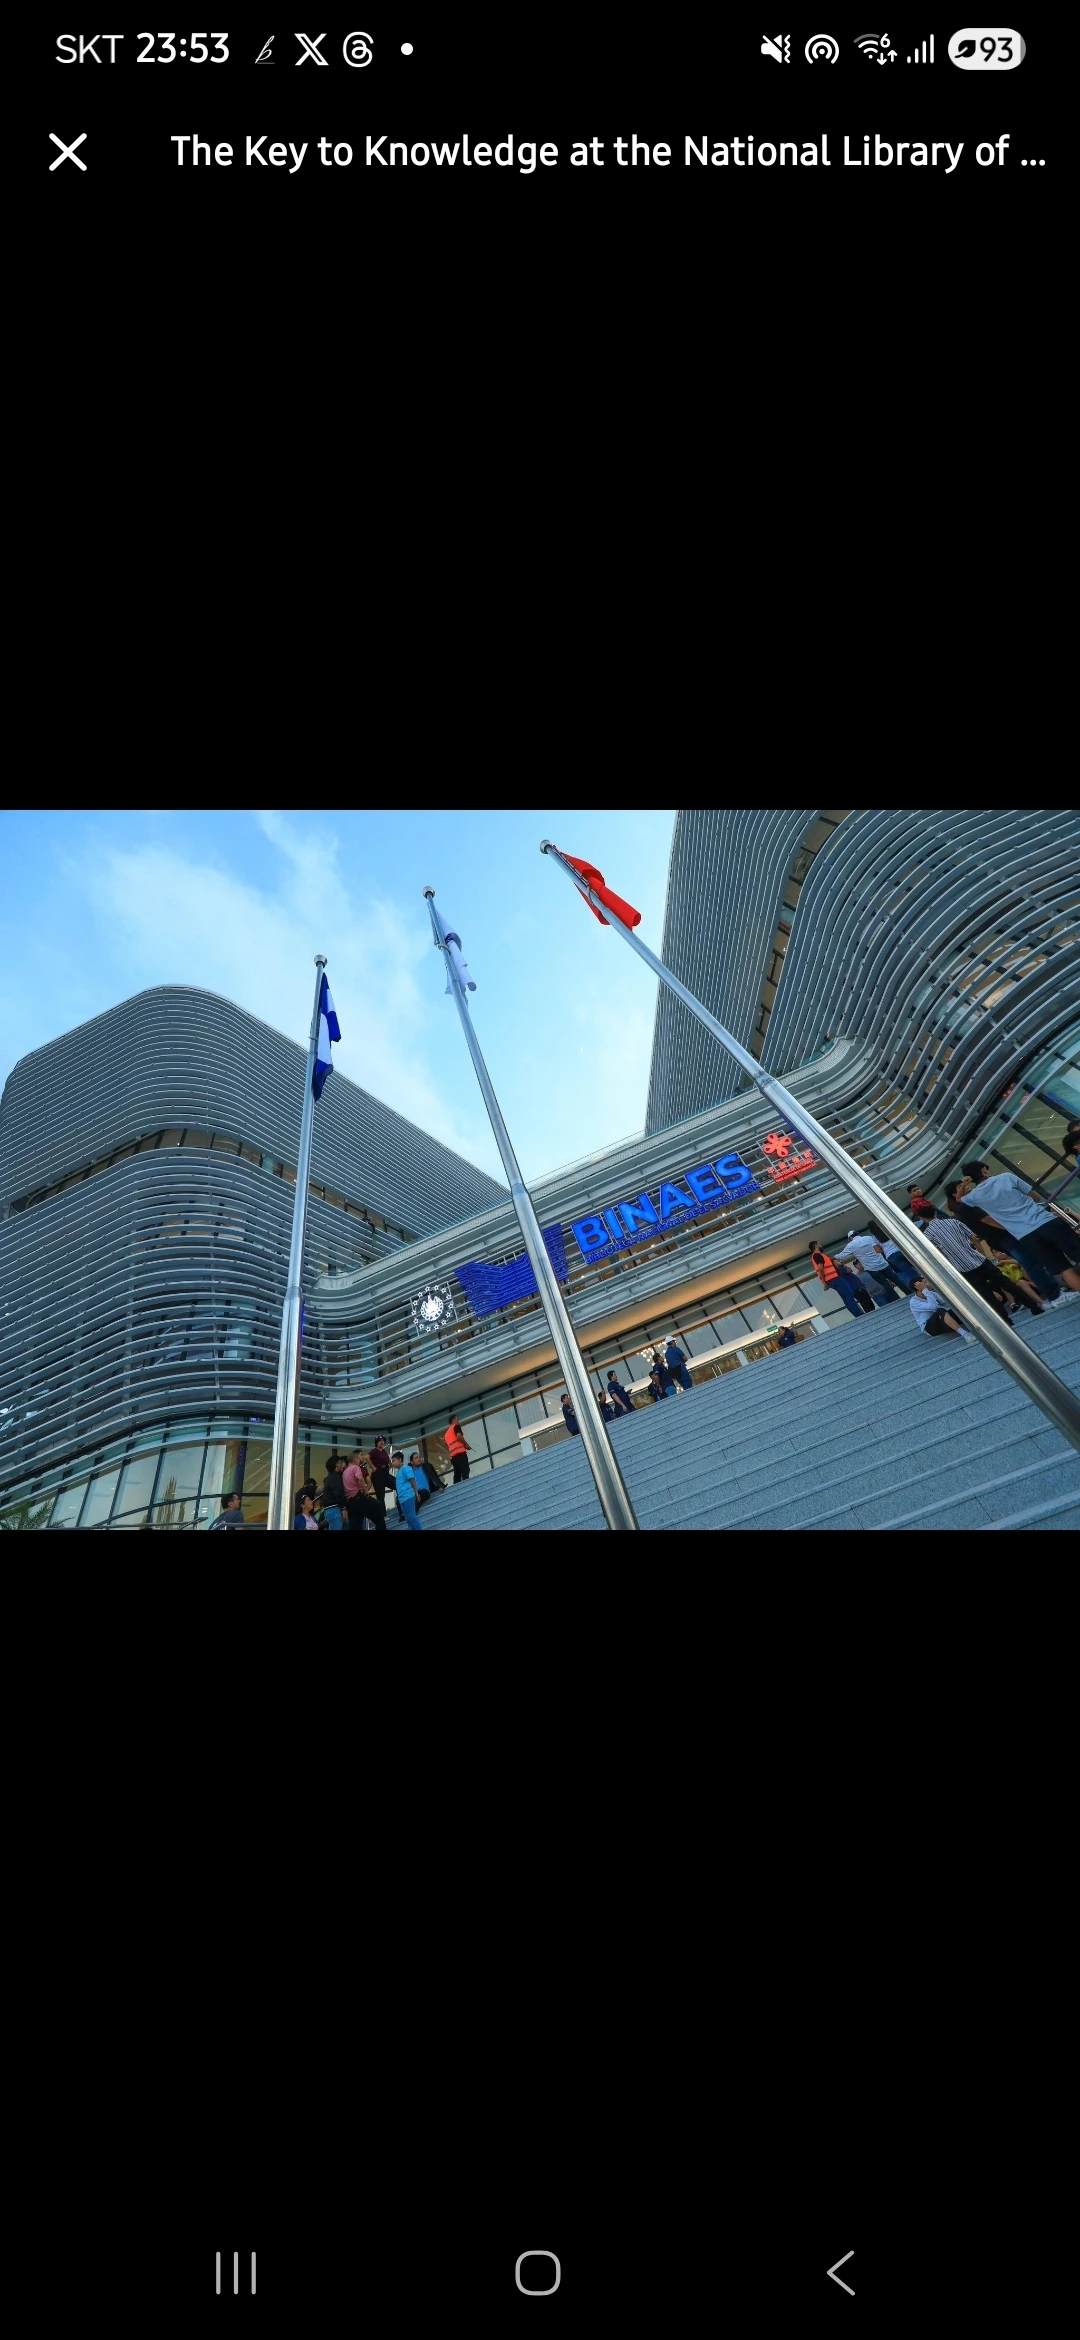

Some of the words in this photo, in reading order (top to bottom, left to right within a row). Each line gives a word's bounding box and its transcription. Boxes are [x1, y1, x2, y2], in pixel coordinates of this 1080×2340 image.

[571, 1152, 753, 1254] BINAES
[585, 1237, 637, 1265] BIBLIOTECA
[638, 1217, 684, 1243] NACIONAL
[685, 1210, 698, 1221] DE
[709, 1182, 762, 1209] SALVADOR
